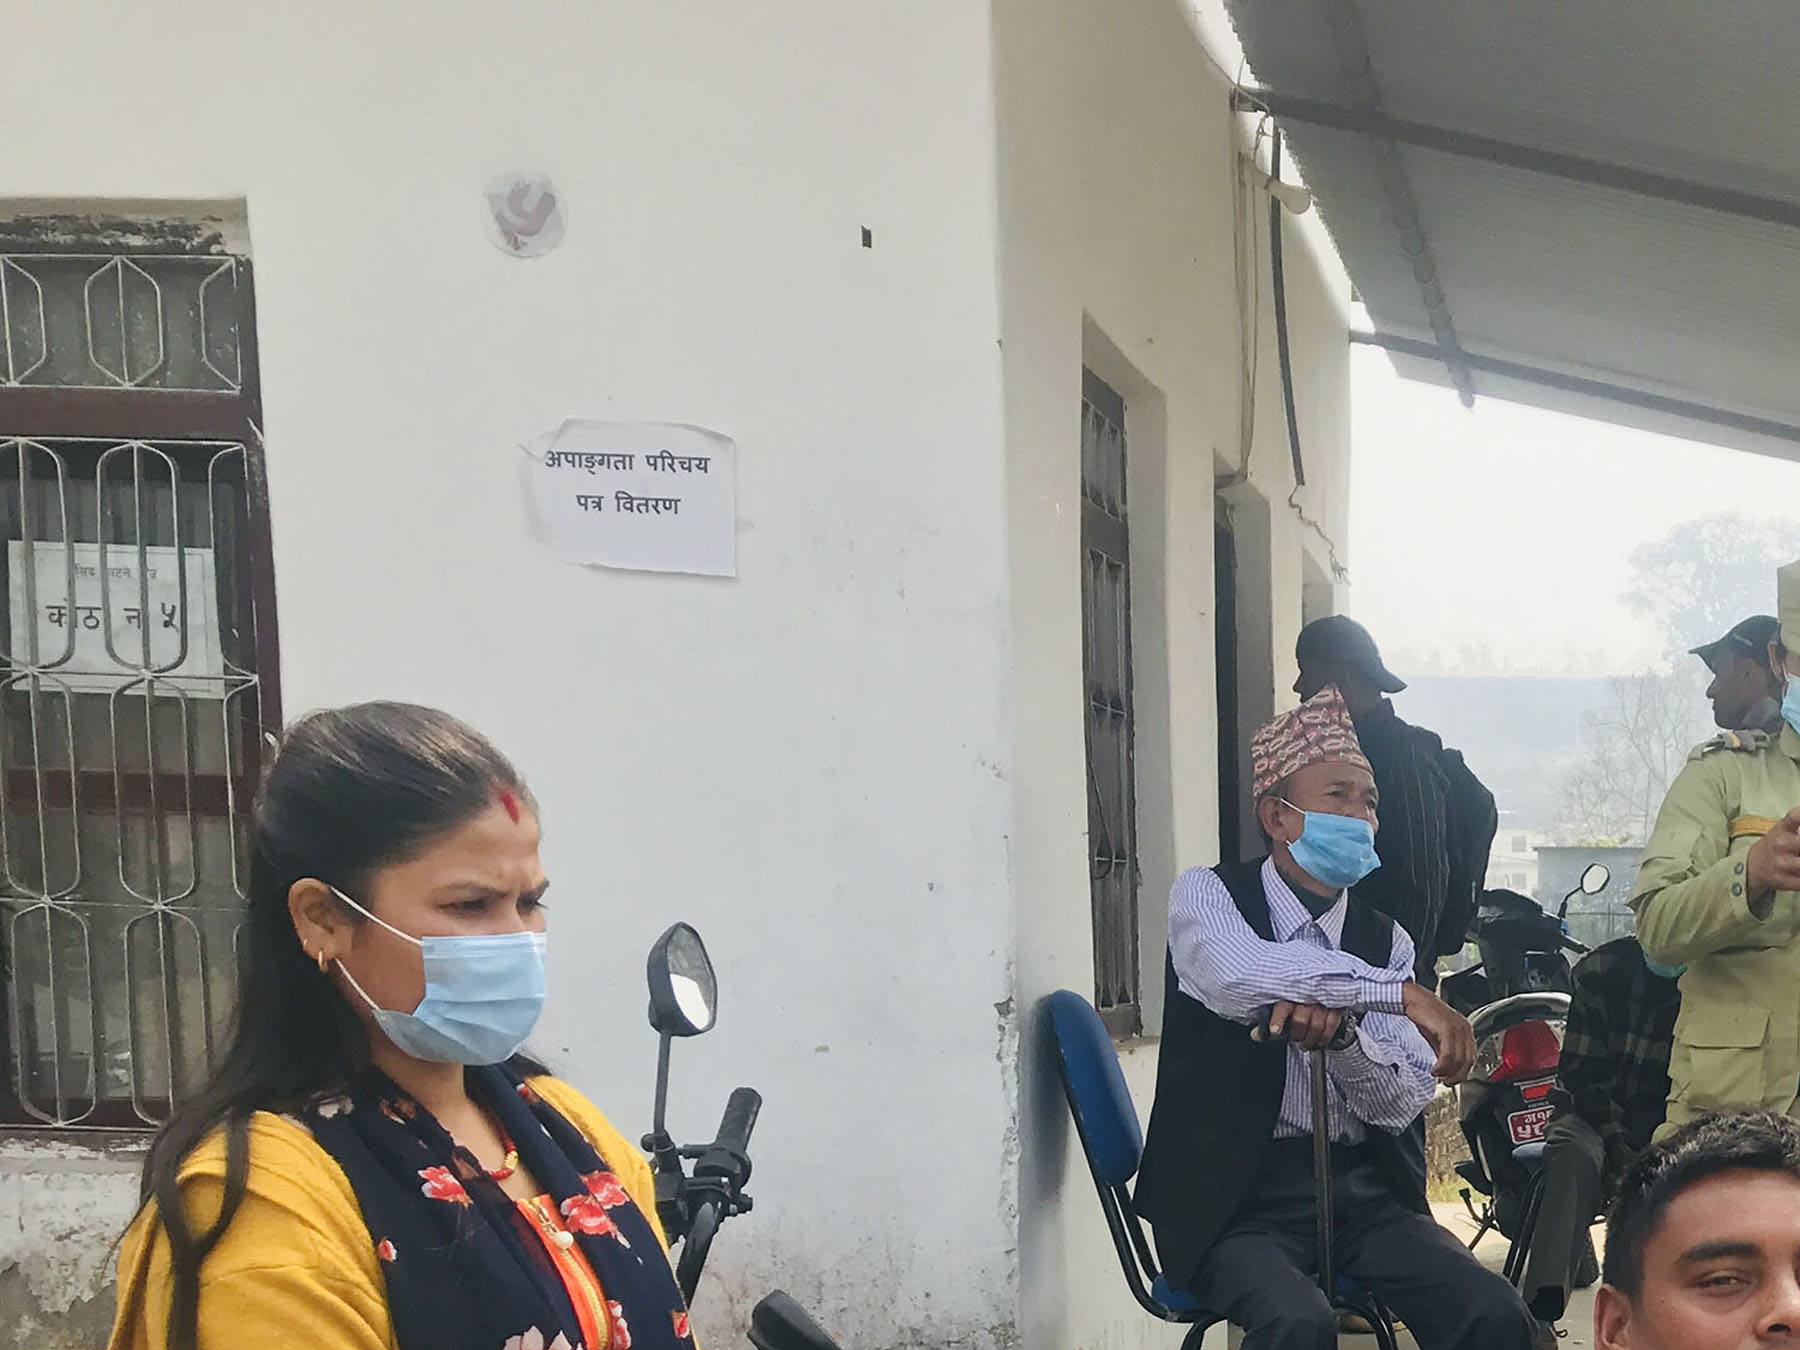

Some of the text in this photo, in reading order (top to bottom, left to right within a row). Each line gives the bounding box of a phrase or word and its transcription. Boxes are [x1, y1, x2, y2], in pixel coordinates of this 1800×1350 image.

[545, 450, 711, 475] अपाङ्गता परिचय
[576, 491, 681, 514] पत्र वितरण
